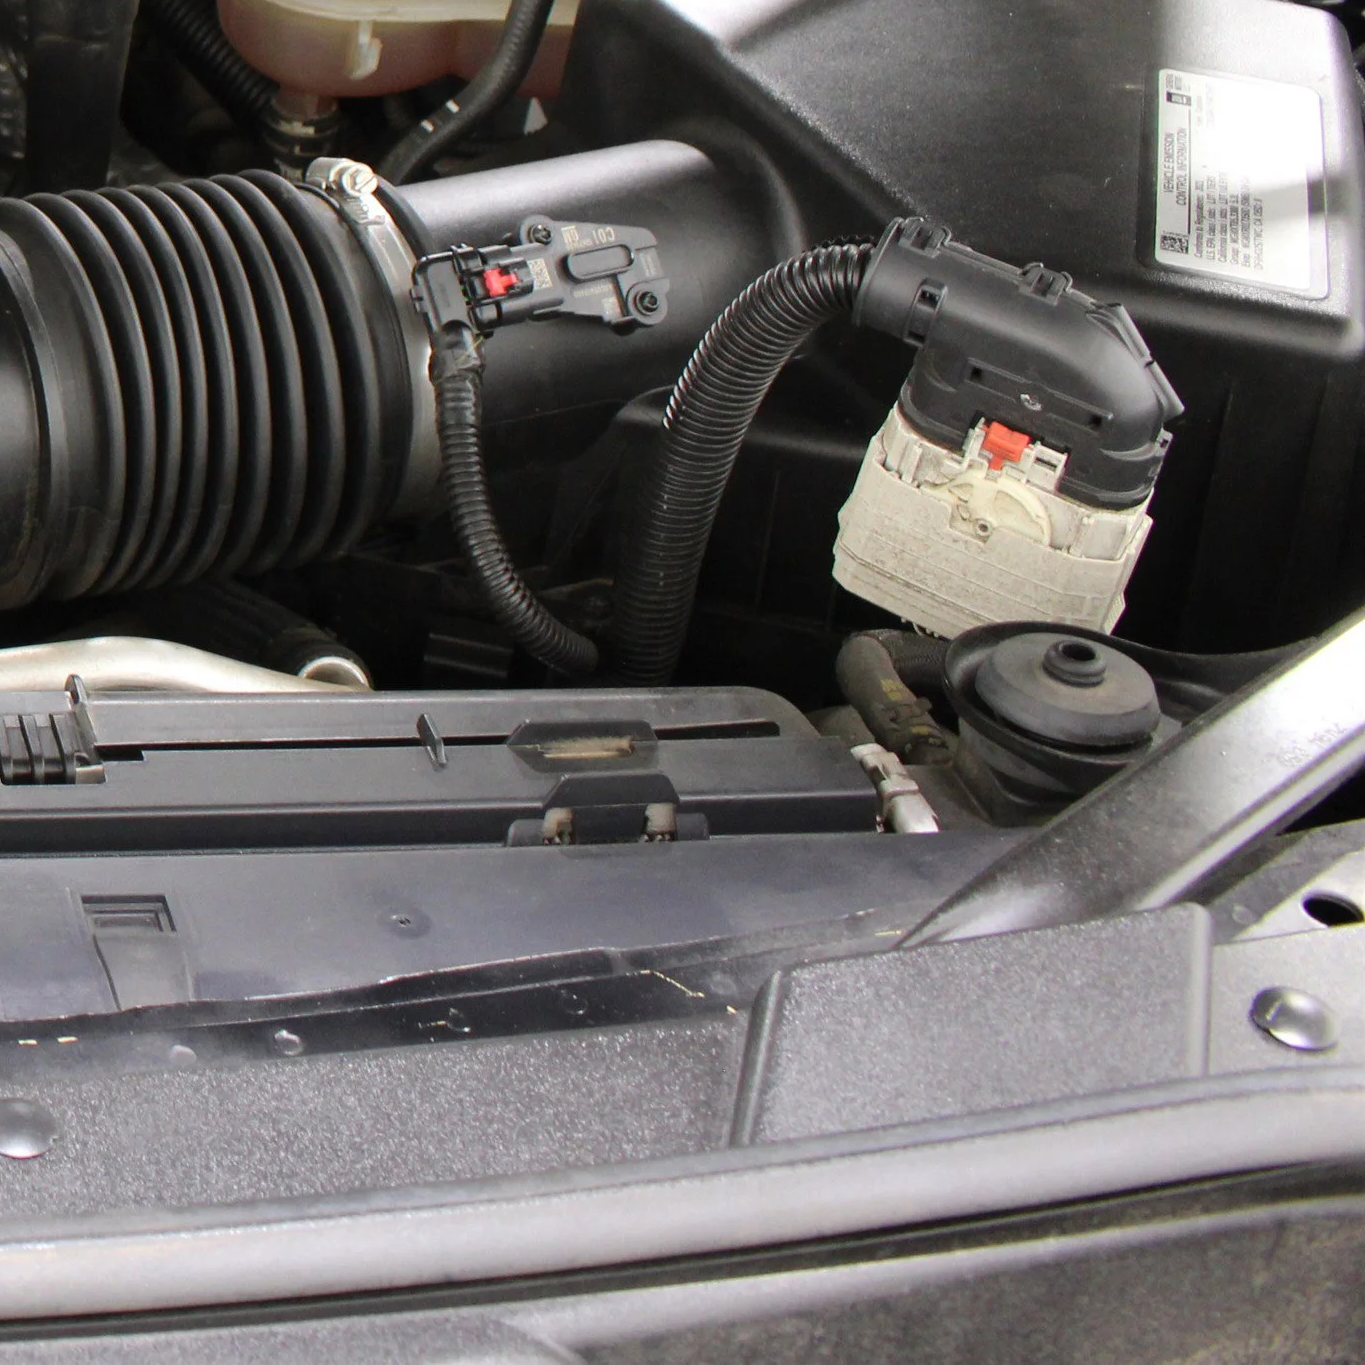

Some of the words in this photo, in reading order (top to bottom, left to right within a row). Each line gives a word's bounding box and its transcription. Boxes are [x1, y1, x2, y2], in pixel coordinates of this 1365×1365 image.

[1164, 131, 1175, 163] EMISSION
[1177, 127, 1187, 171] INFORMATION
[1163, 165, 1174, 193] VEHICLE
[1176, 173, 1187, 205] CONTROL
